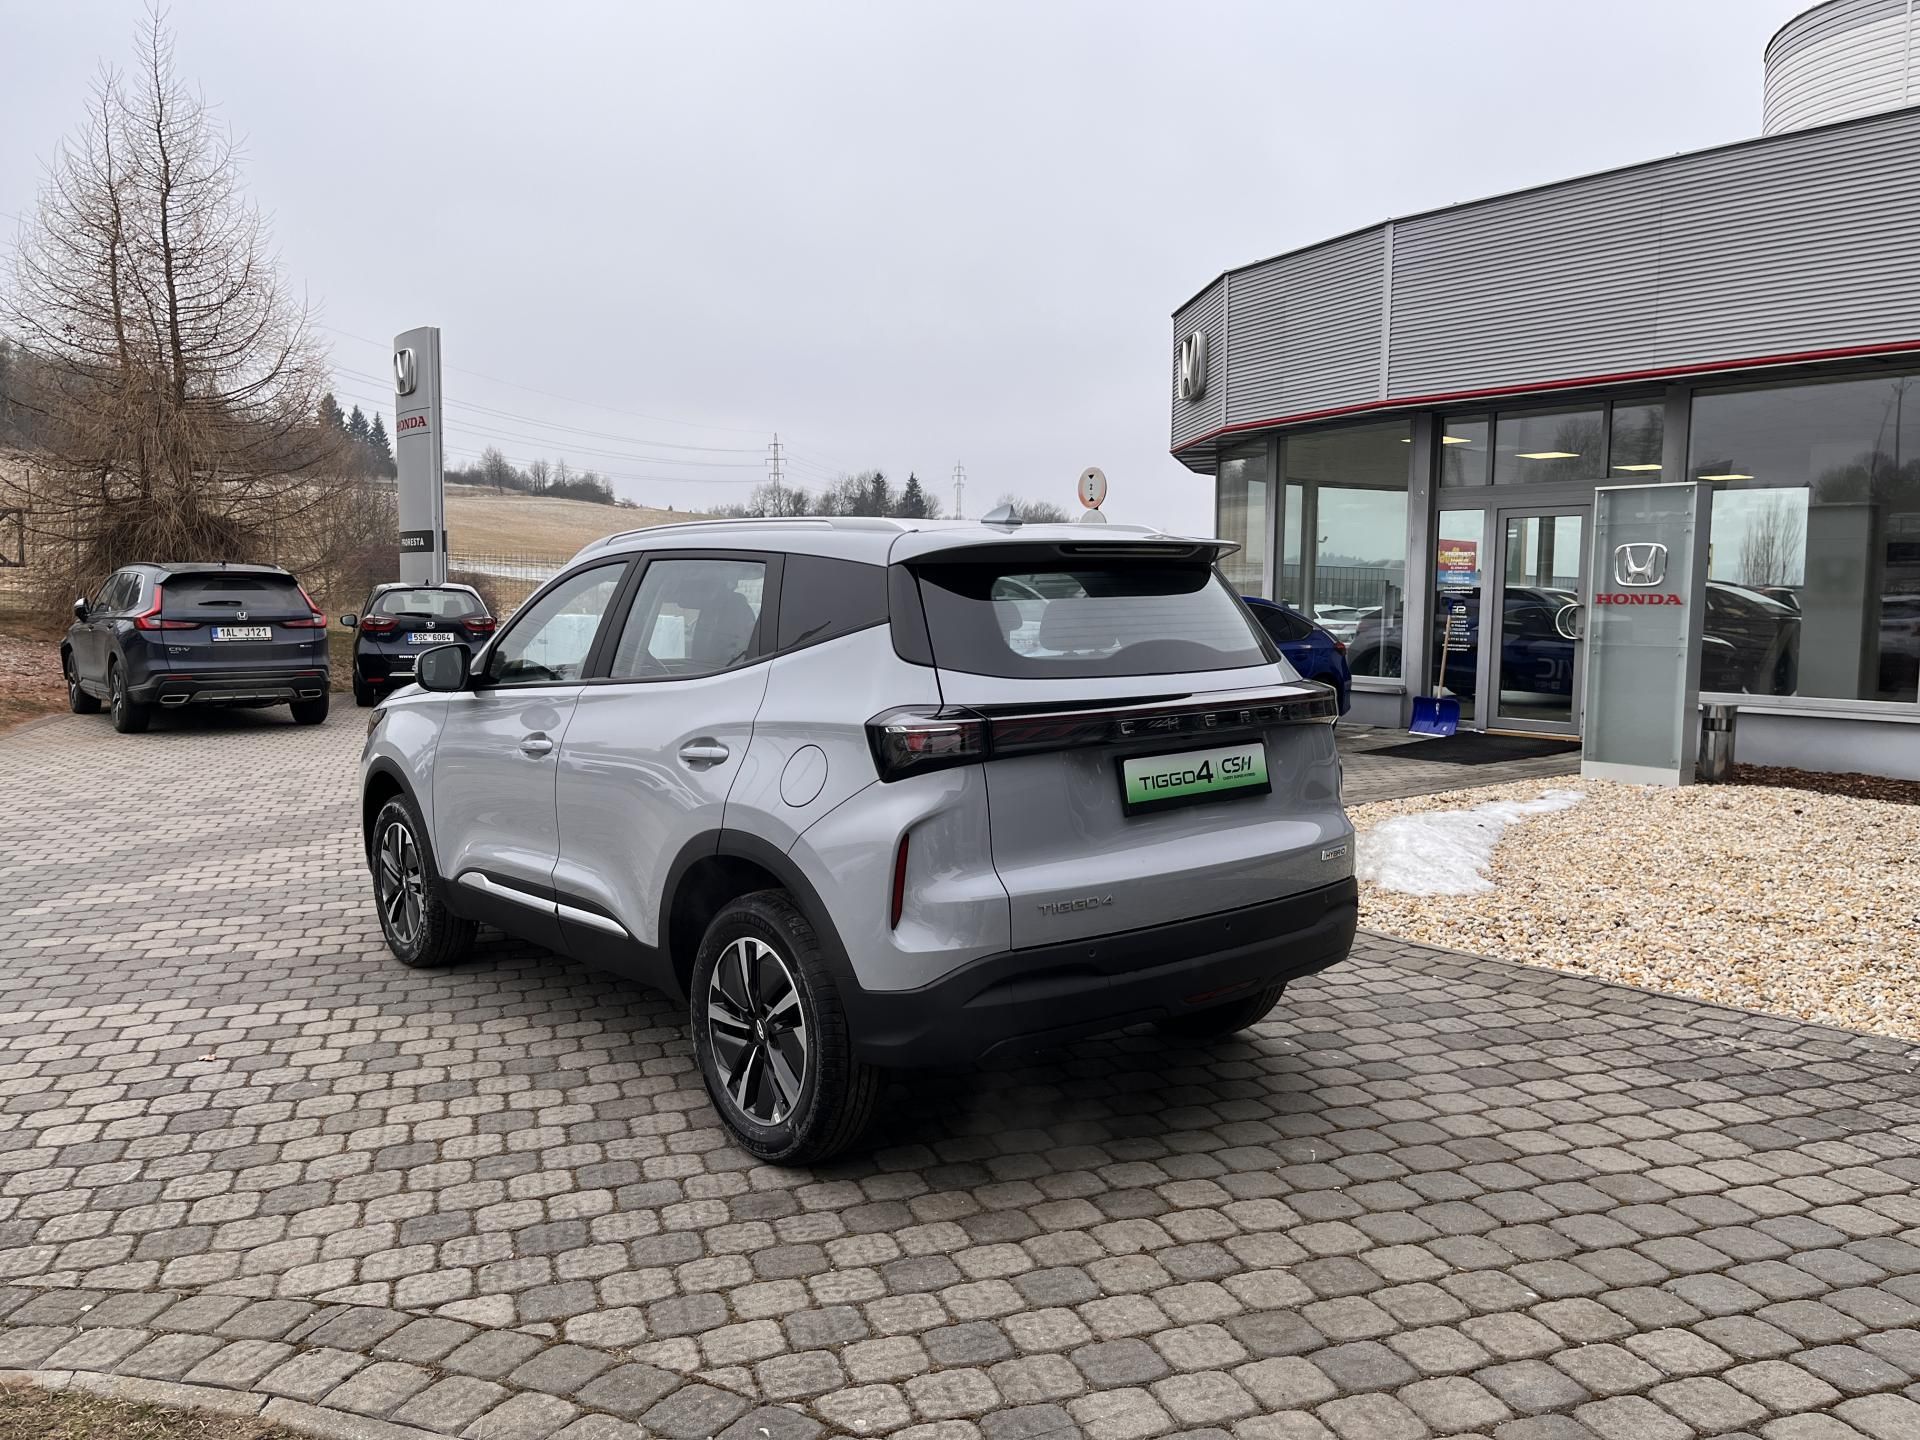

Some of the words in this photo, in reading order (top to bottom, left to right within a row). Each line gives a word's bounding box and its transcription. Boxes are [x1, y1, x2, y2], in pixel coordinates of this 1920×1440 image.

[1595, 593, 1683, 605] HONDA
[220, 628, 237, 637] 1AL
[244, 627, 267, 637] J121
